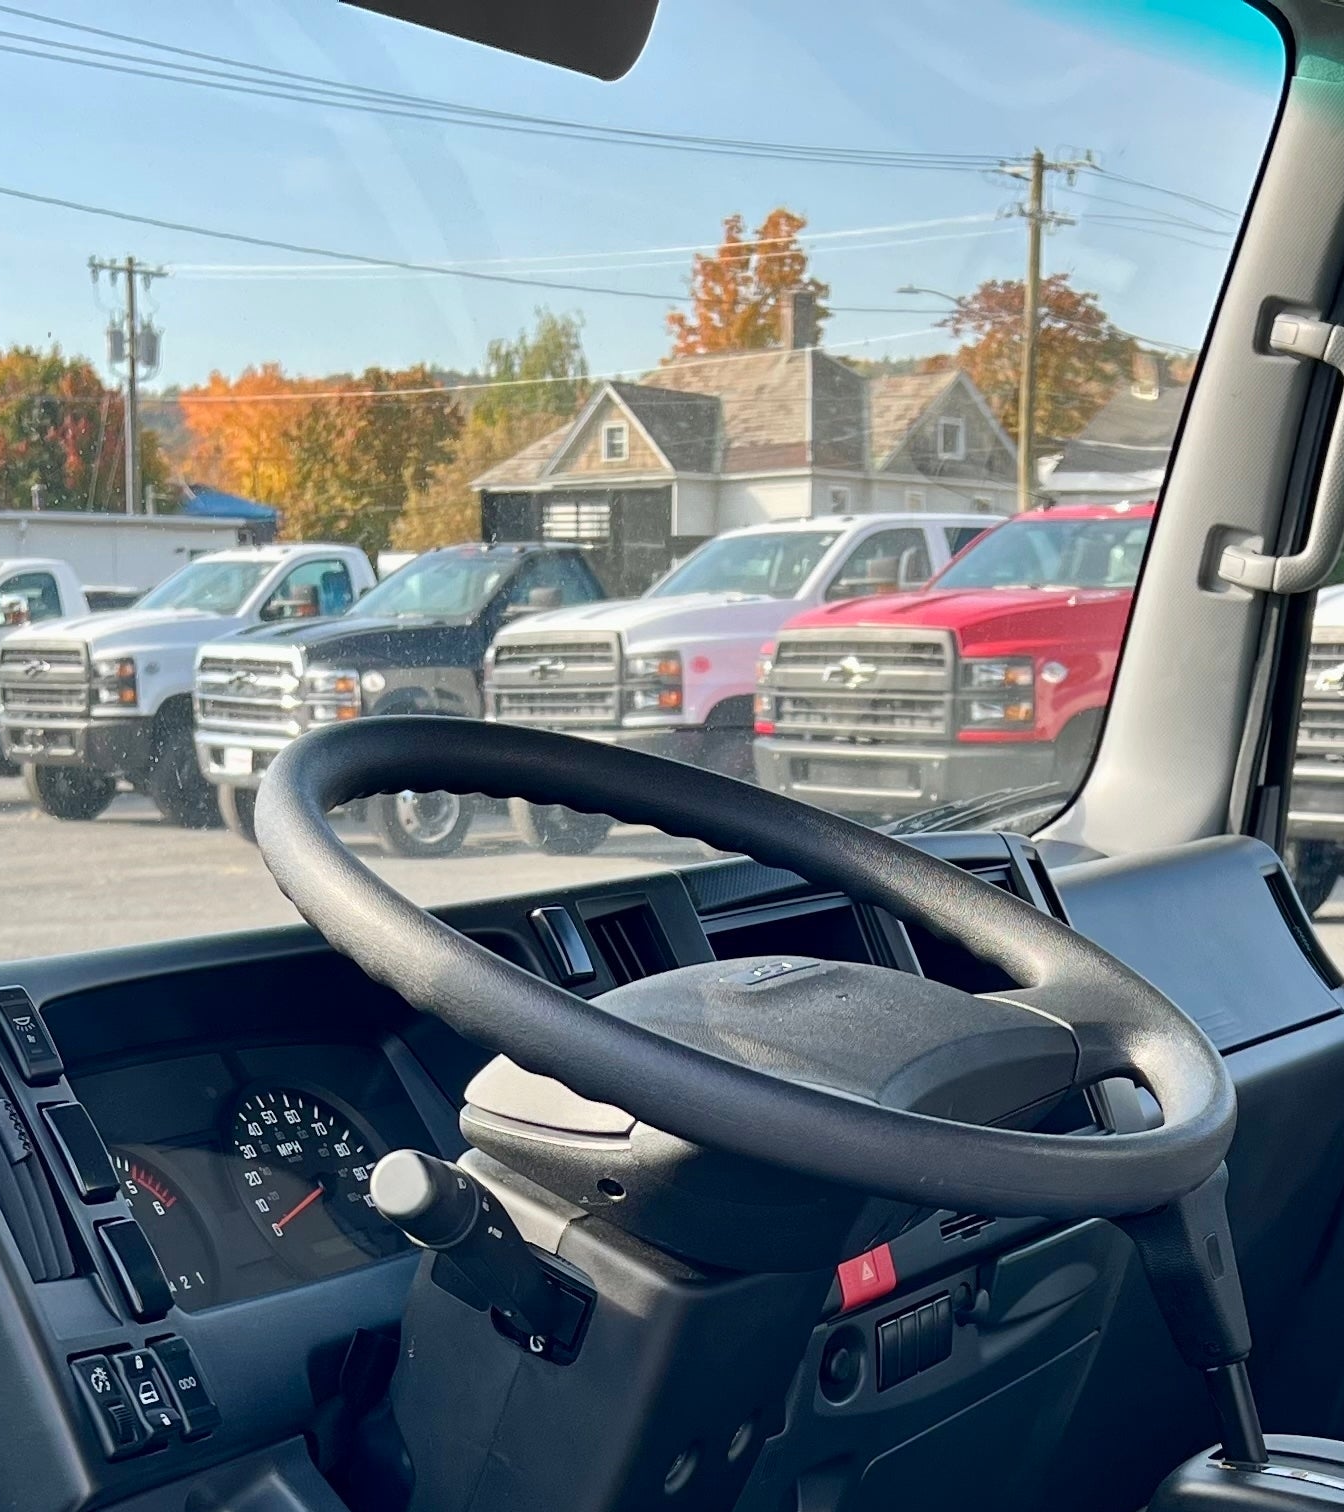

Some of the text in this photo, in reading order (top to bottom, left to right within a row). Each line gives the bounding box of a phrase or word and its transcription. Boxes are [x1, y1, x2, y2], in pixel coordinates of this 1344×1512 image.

[261, 1110, 278, 1125] 50
[284, 1109, 301, 1124] 60
[248, 1122, 263, 1136] 40
[311, 1122, 328, 1136] 70
[240, 1144, 257, 1159] 30
[276, 1140, 303, 1157] MPH
[334, 1142, 351, 1157] 80
[245, 1171, 262, 1186] 20
[125, 1180, 138, 1194] 5
[152, 1201, 165, 1215] 6
[255, 1198, 269, 1213] 10
[179, 1275, 192, 1290] 2
